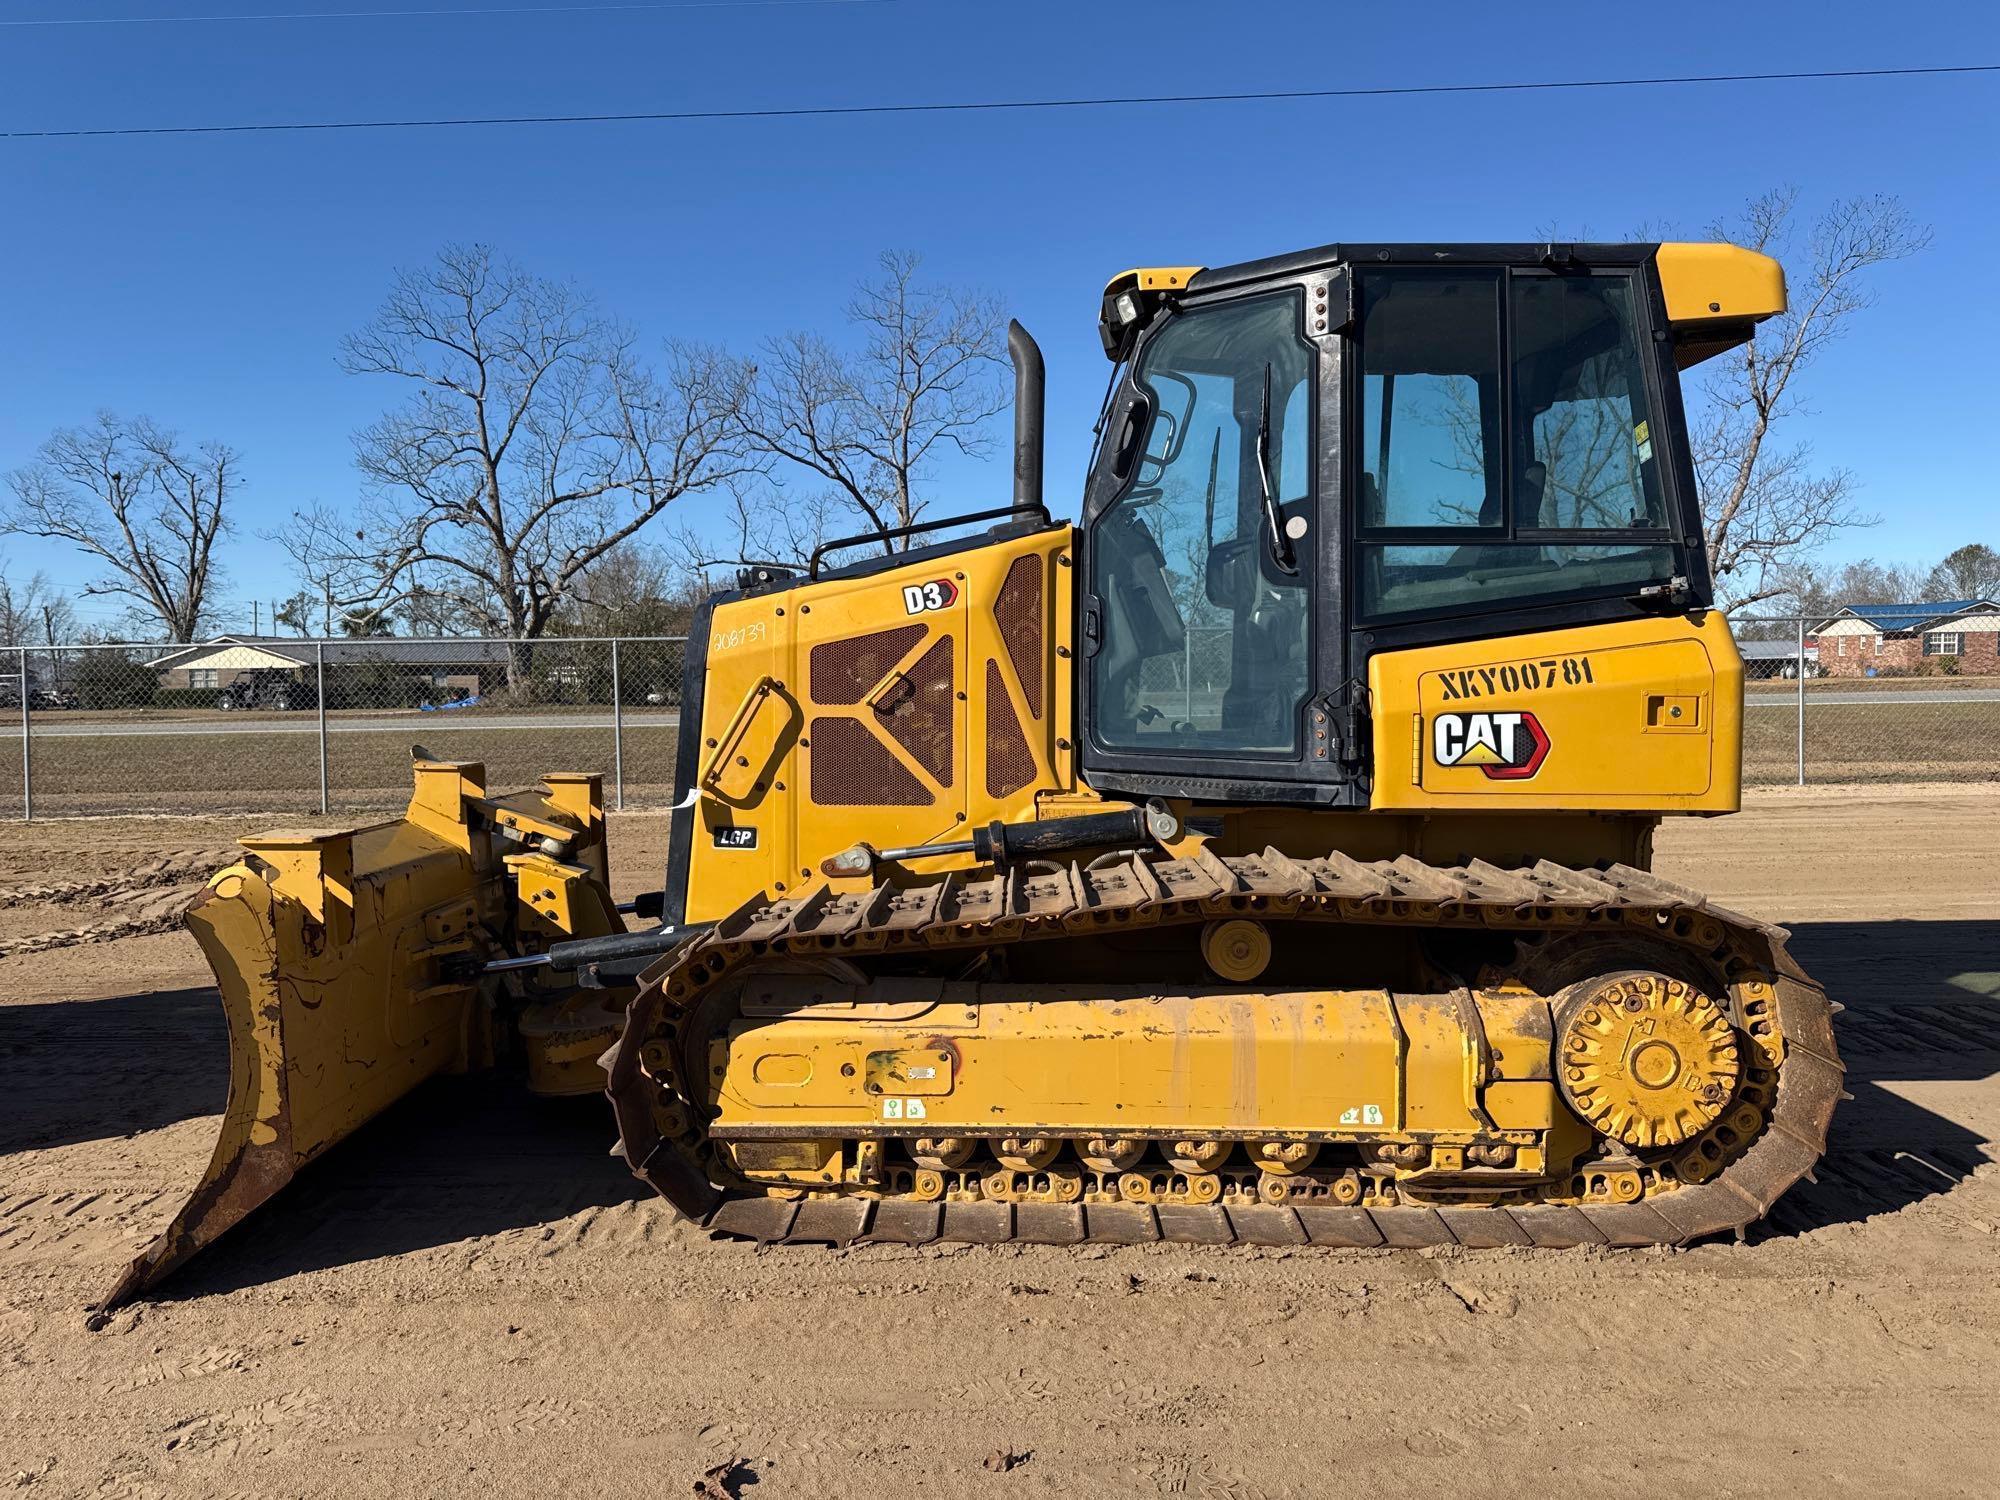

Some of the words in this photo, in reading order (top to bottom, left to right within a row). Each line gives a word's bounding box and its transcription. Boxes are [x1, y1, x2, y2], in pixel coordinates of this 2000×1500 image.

[903, 582, 943, 614] D3
[714, 622, 766, 652] 208739
[1438, 657, 1594, 700] XKY00781
[1434, 713, 1522, 766] CAT
[720, 830, 752, 845] LGP
